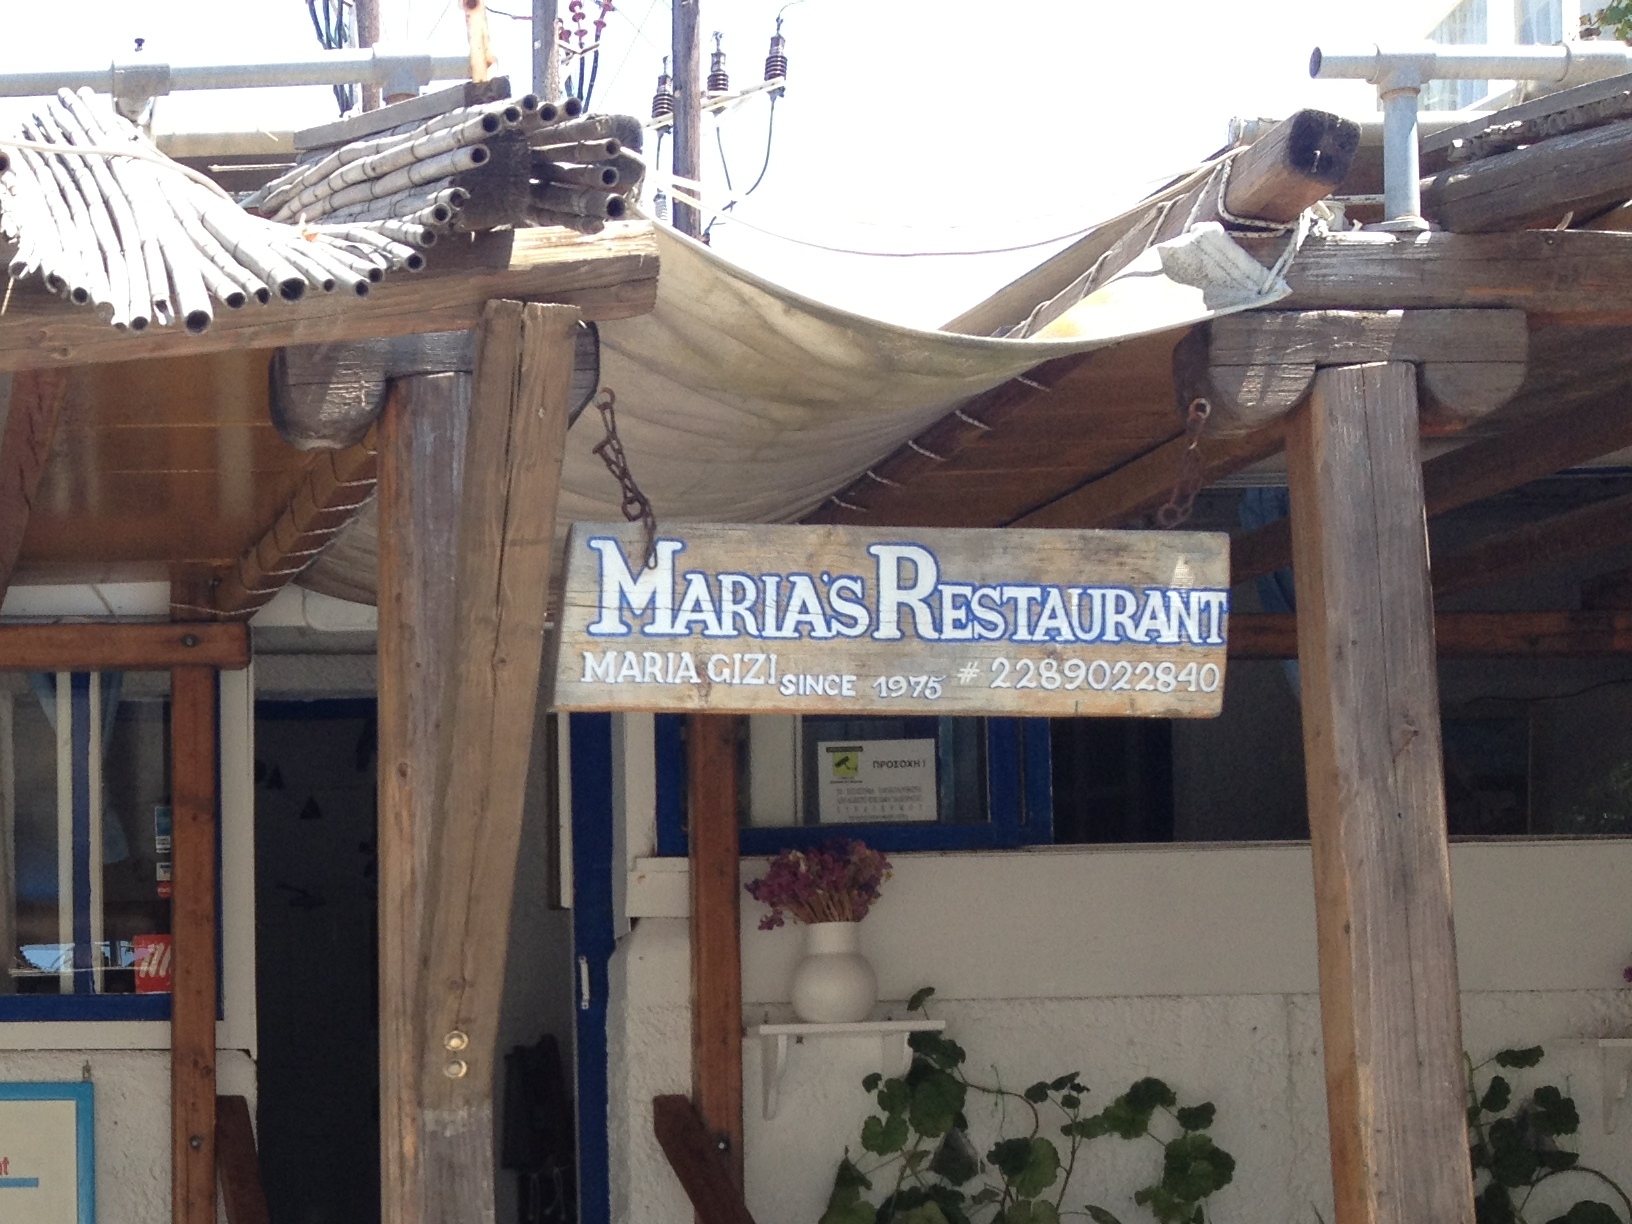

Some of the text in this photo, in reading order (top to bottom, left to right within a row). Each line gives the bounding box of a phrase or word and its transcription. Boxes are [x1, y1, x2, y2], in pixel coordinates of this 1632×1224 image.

[587, 537, 1231, 646] MARIA'S RESTAURANT
[580, 650, 1221, 700] MARIA GIZI SINCE 1975 # 2289022840
